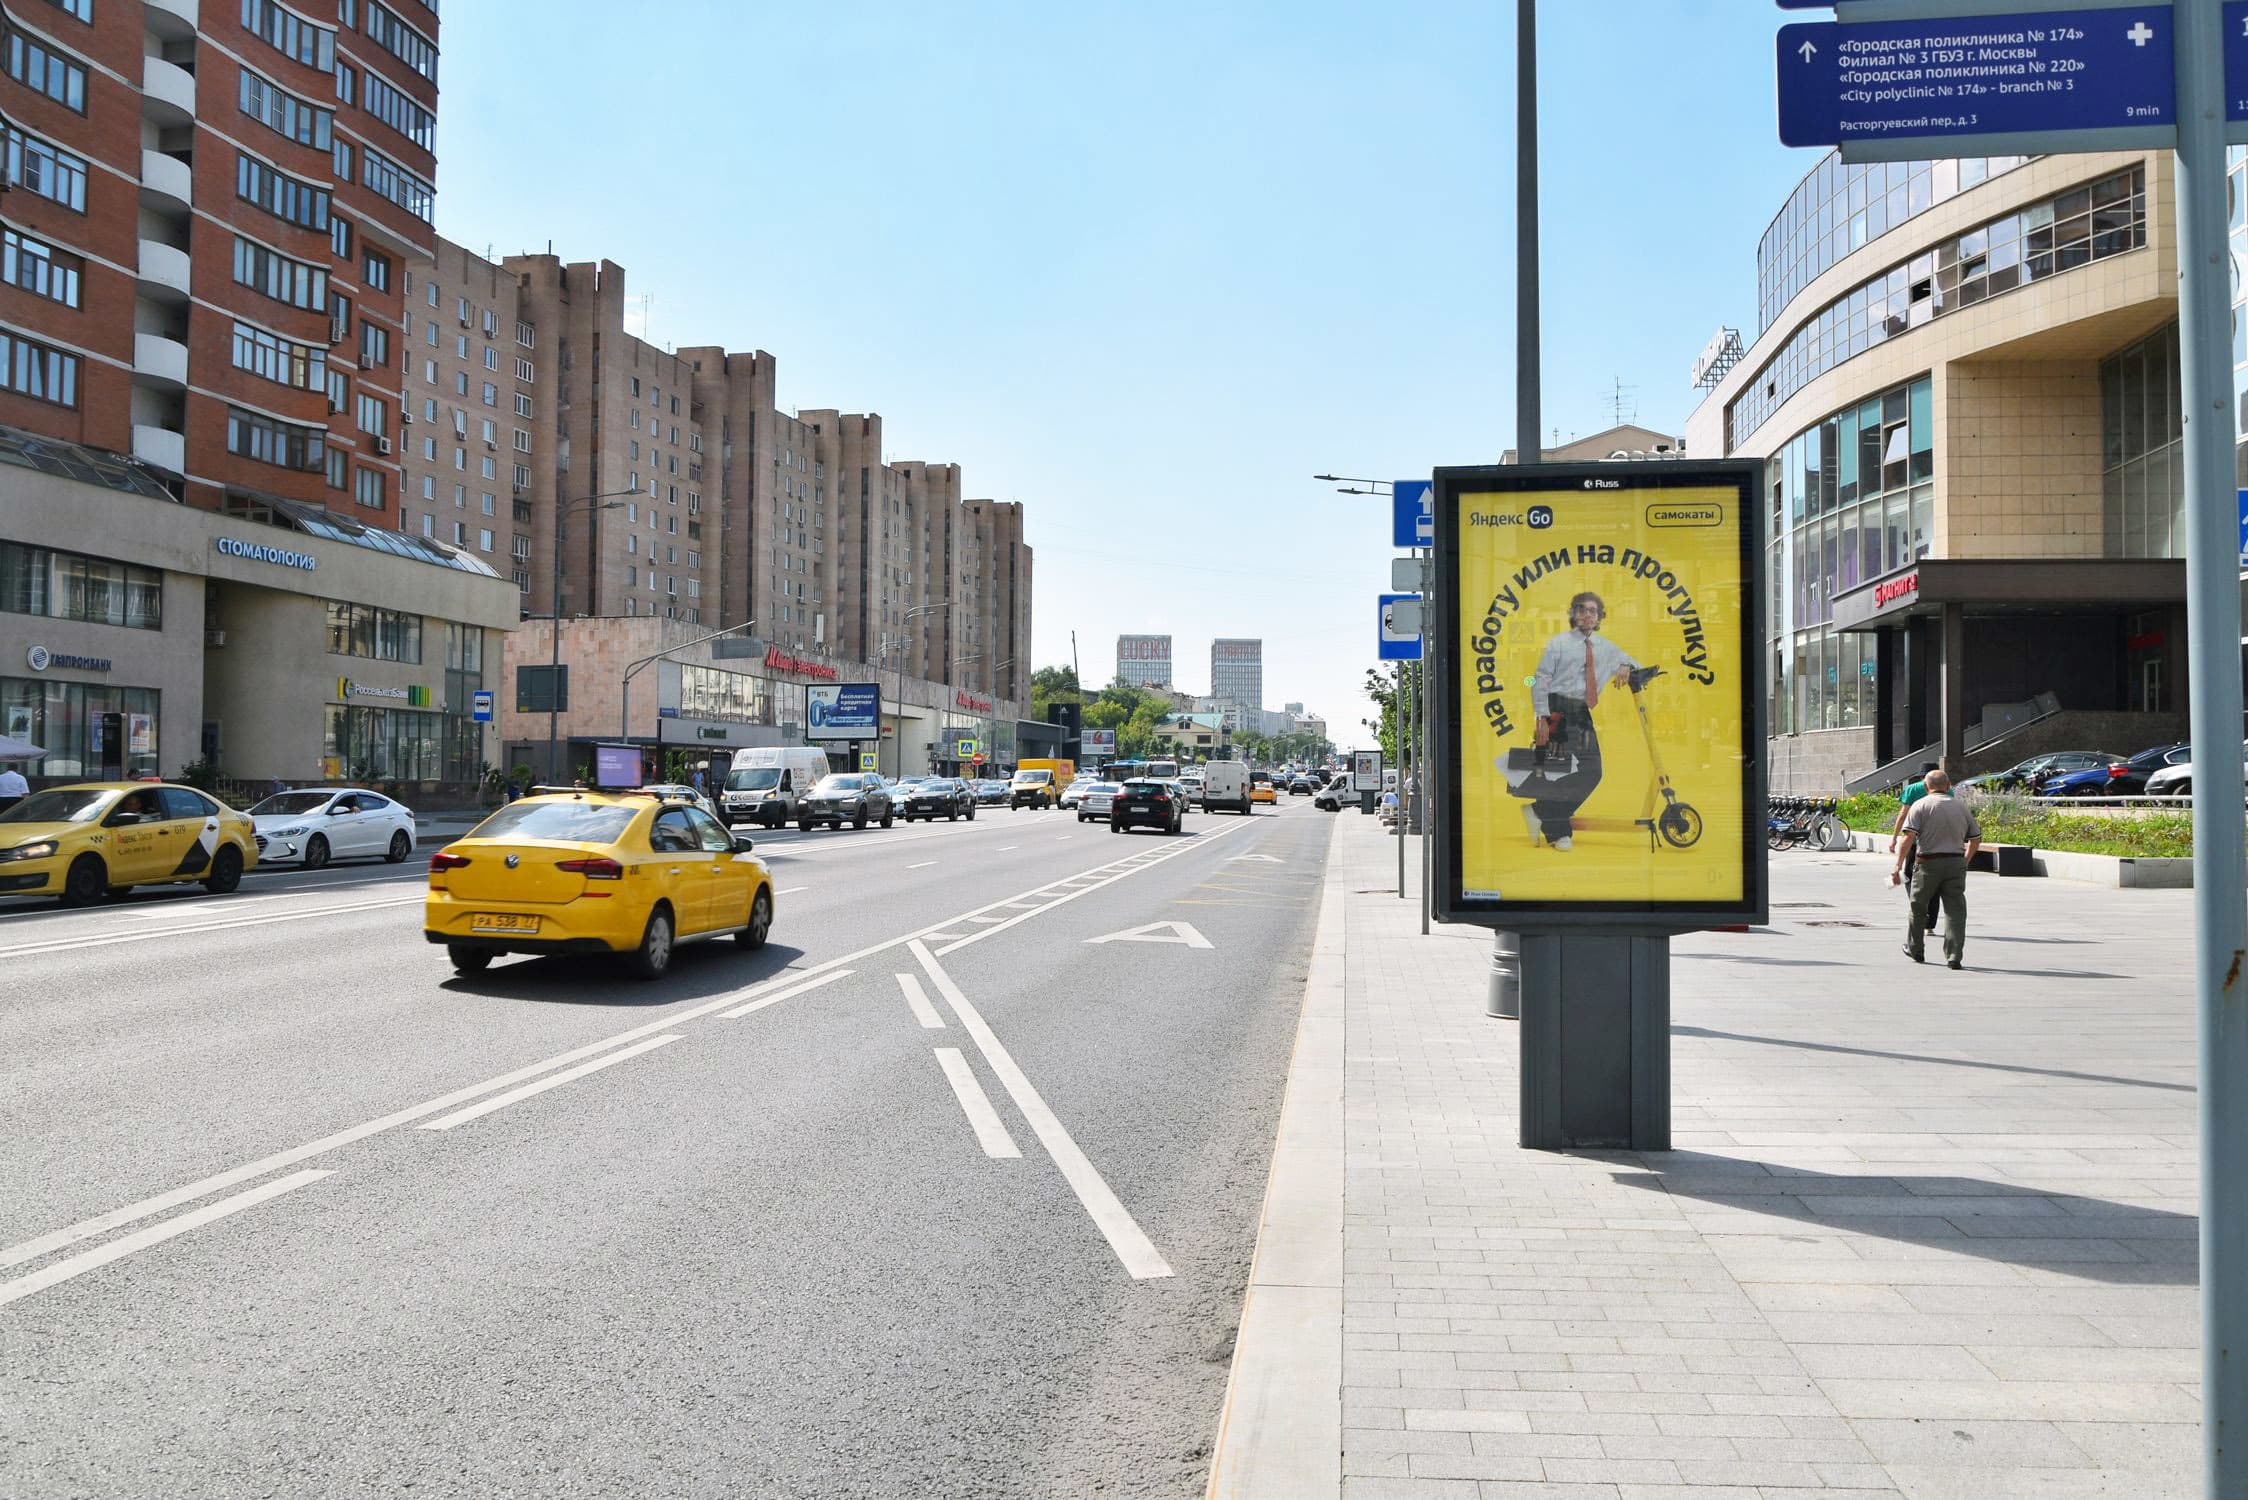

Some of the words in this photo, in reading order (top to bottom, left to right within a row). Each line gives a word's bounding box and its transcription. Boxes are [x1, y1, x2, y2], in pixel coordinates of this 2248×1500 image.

[1838, 40, 1921, 55] «Городская
[1924, 33, 2024, 48] поликлиника
[2027, 30, 2045, 42] №
[2049, 28, 2084, 41] 174»
[1838, 55, 1896, 68] Филиал
[1899, 52, 1916, 65] №
[1920, 51, 1928, 64] 3
[1932, 49, 1964, 63] ГБУЗ
[1967, 51, 1976, 61] г.
[1979, 48, 2037, 61] Москвы
[1839, 69, 1922, 86] «Городская
[1926, 63, 2025, 78] поликлиника
[2028, 61, 2046, 73] №
[2050, 59, 2085, 73] 220»
[1840, 89, 1872, 103] «City
[1875, 86, 1936, 102] polyclinic
[1938, 85, 1953, 96] №
[1957, 84, 1987, 96] 174»
[1999, 80, 2044, 93] branch
[2047, 80, 2062, 91] №
[2066, 79, 2074, 90] 3
[2126, 106, 2134, 117] 9
[2136, 105, 2160, 116] min
[1840, 117, 1928, 131] Расторгуевский
[1970, 114, 1977, 124] 3
[1595, 480, 1619, 488] Russ
[1470, 511, 1524, 527] Яндекс
[1529, 510, 1551, 525] Go
[1654, 510, 1715, 520] самокаты
[218, 538, 316, 570] СТОМАТОЛОГИЯ
[1577, 544, 1615, 564] на
[1512, 547, 1571, 590] или
[1620, 548, 1714, 685] прогулку?
[1120, 639, 1168, 660] LUCKY
[1471, 584, 1520, 694] работу
[1484, 698, 1514, 737] на
